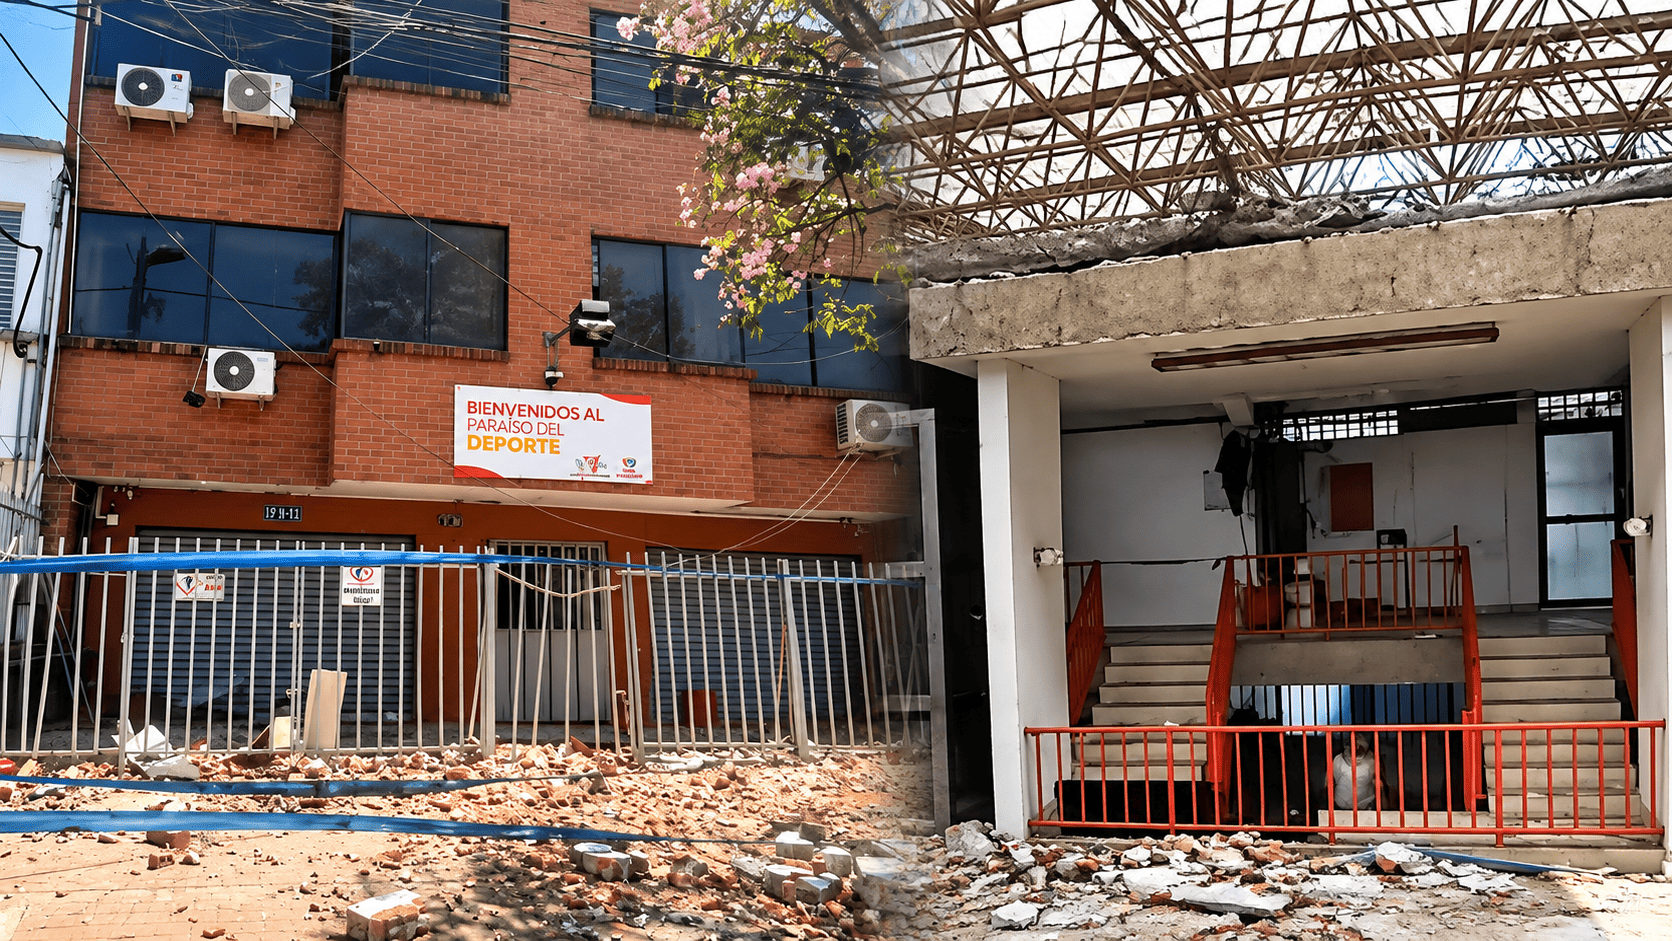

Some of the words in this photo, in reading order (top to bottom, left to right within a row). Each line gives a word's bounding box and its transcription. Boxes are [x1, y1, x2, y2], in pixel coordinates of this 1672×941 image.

[467, 400, 580, 420] BIENVENIDOS
[583, 408, 605, 422] AL
[467, 418, 533, 434] PARAÍSO
[537, 422, 565, 436] DEL
[467, 434, 560, 454] DEPORTE
